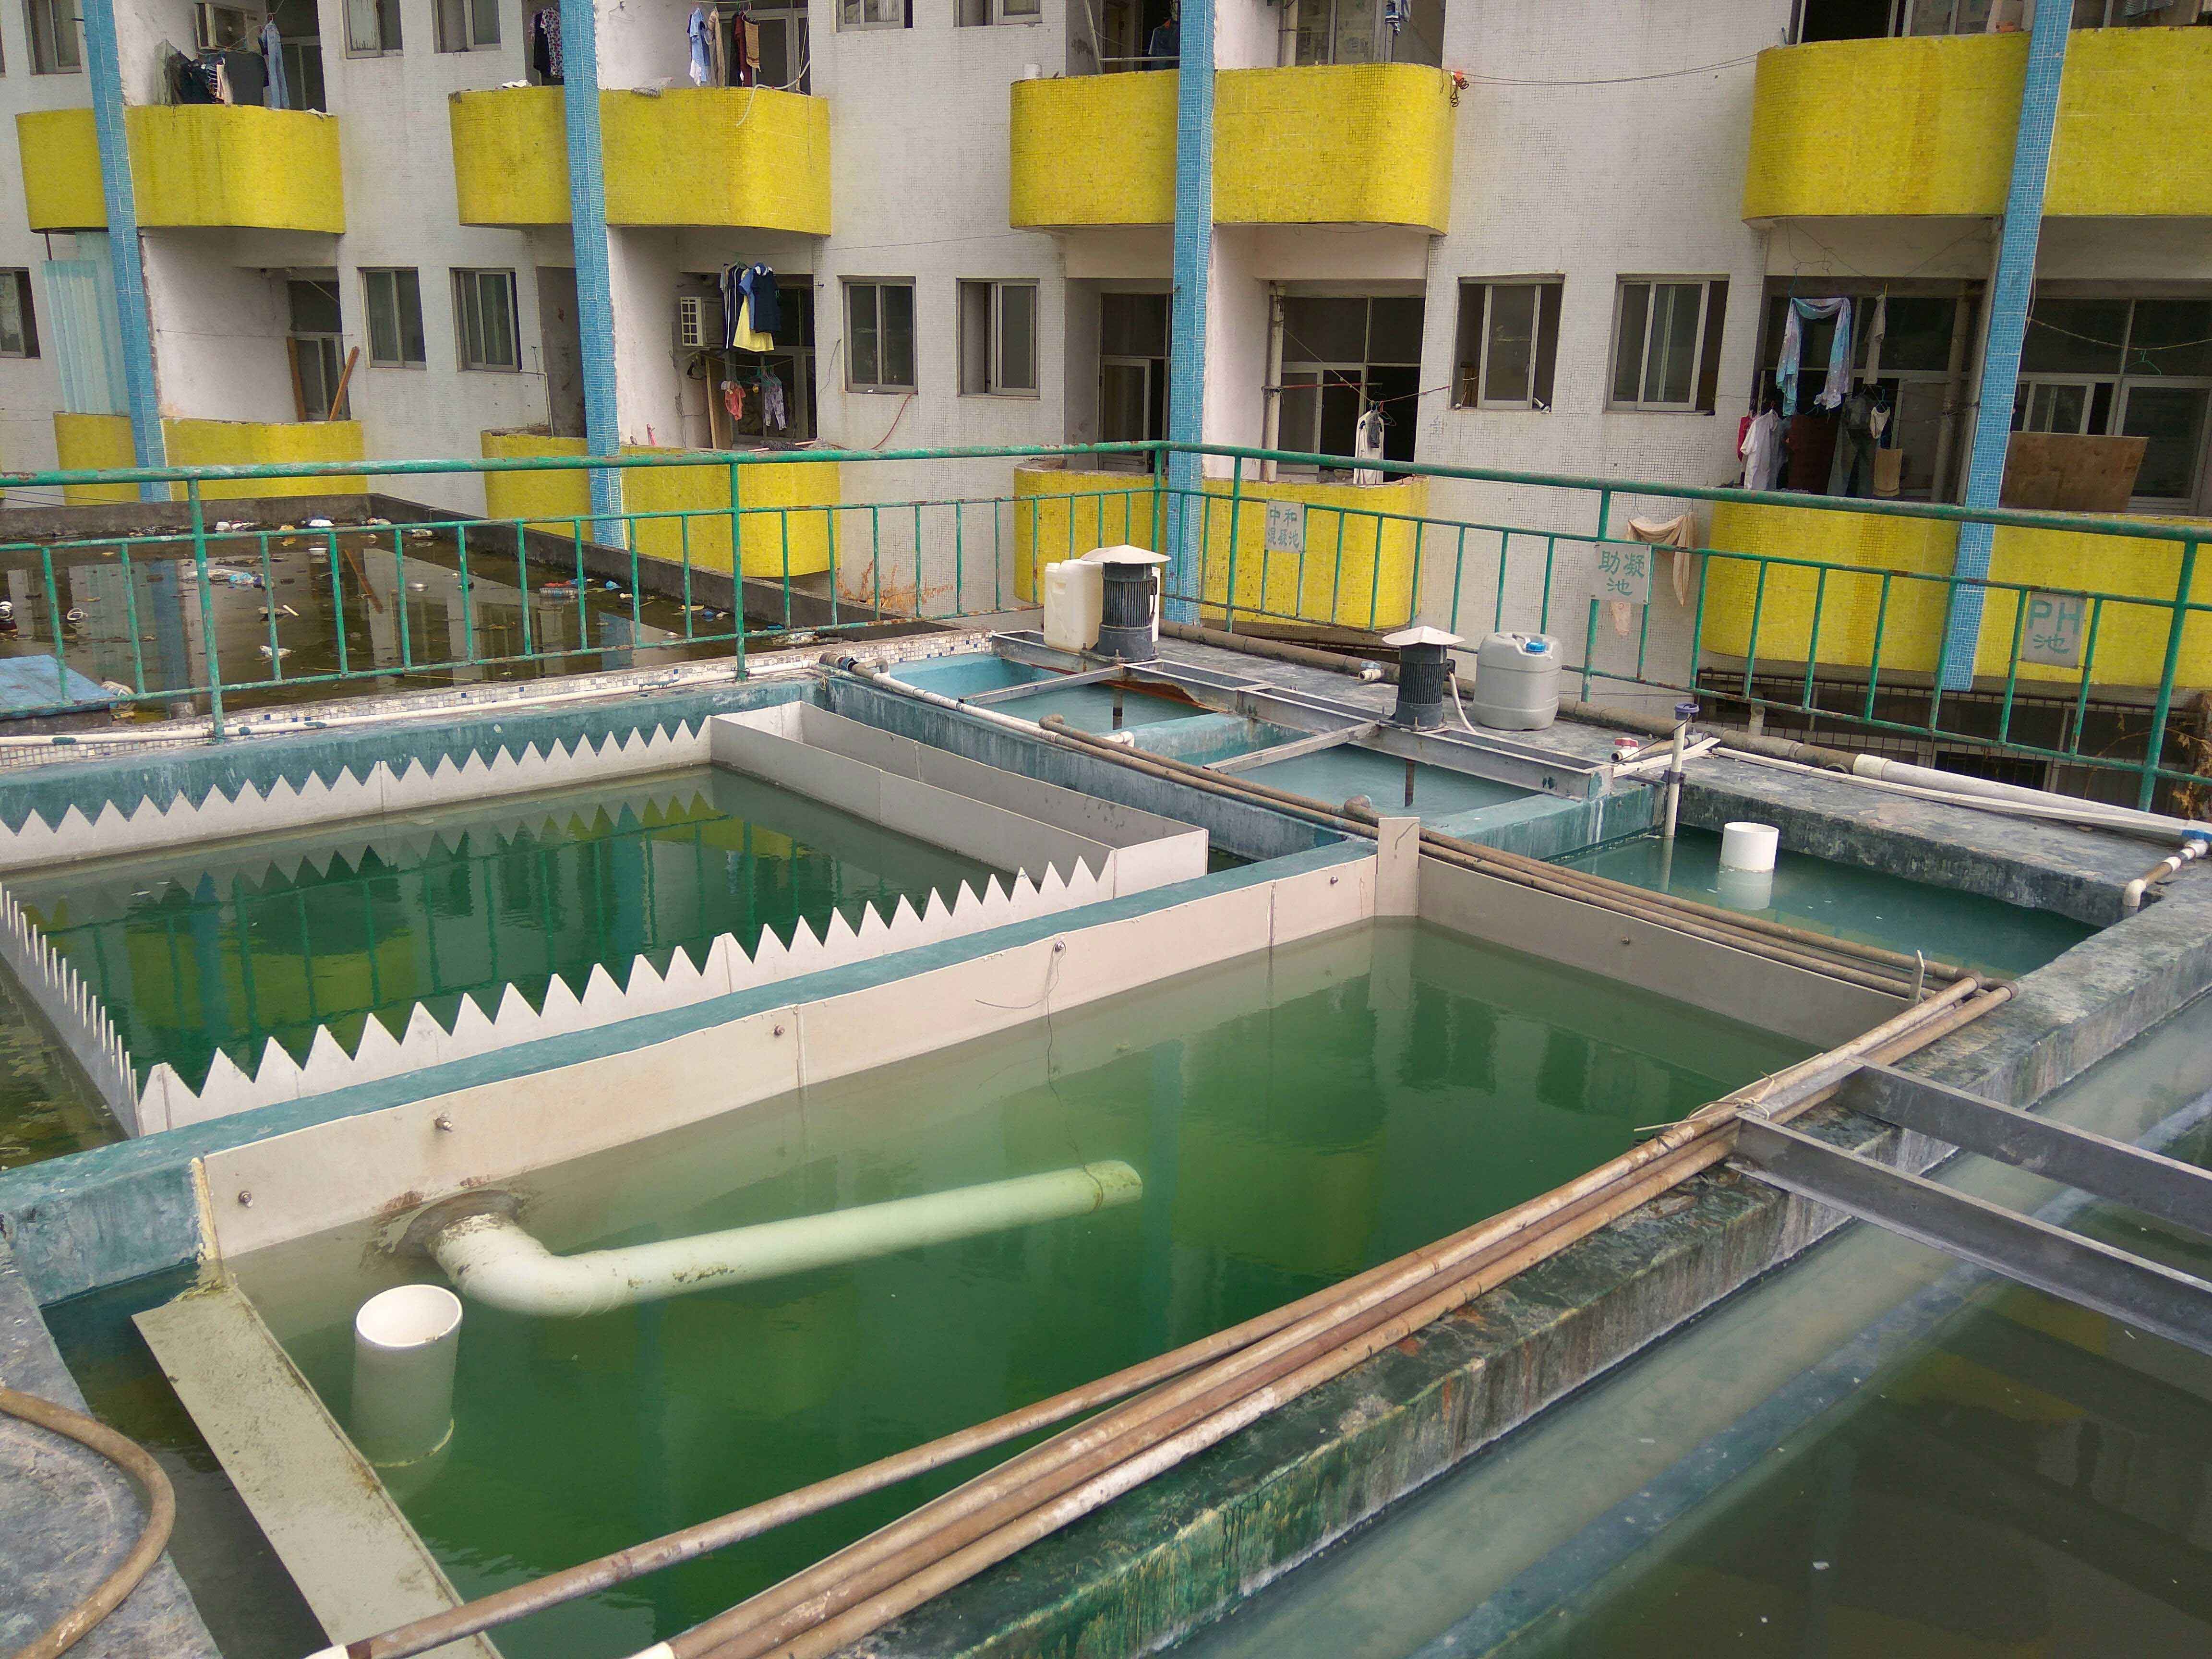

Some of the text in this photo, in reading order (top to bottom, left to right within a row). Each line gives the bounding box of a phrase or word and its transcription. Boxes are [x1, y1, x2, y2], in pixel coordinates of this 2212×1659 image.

[1270, 506, 1297, 527] 中和
[1598, 550, 1645, 578] 助凝
[1606, 577, 1633, 597] 池
[2028, 600, 2084, 634] PH
[2032, 633, 2070, 654] 池
